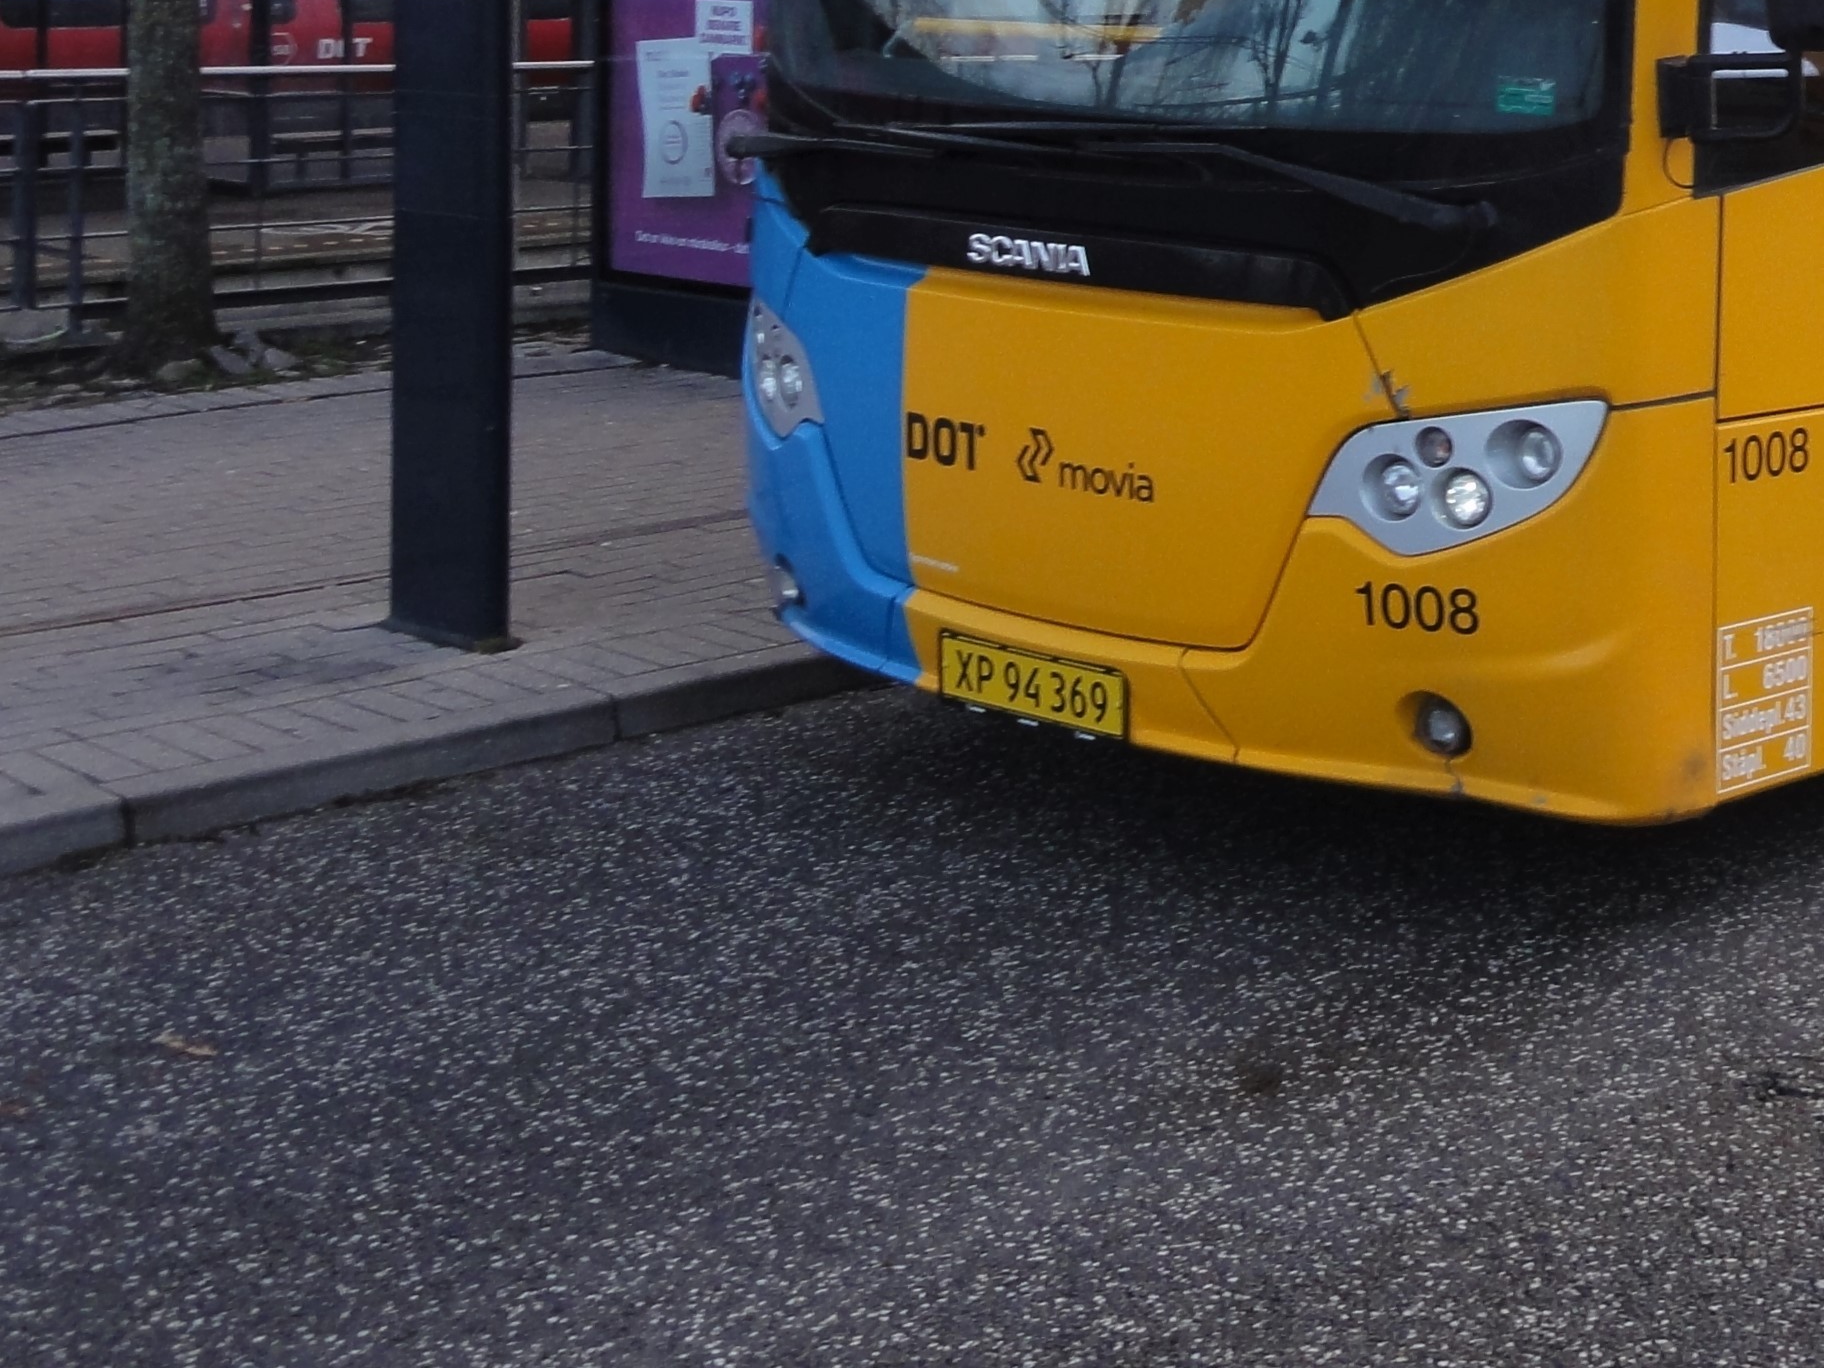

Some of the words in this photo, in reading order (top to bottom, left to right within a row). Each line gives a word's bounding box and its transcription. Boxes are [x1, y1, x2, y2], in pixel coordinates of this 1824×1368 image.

[966, 233, 1091, 277] SCANIA
[906, 411, 983, 471] DOT
[1723, 427, 1808, 484] 1008
[1057, 461, 1156, 504] movia
[1355, 581, 1480, 635] 1008
[954, 648, 996, 695] XP
[1763, 655, 1808, 689] 6500
[1784, 694, 1807, 721] 43
[1783, 733, 1807, 761] 40
